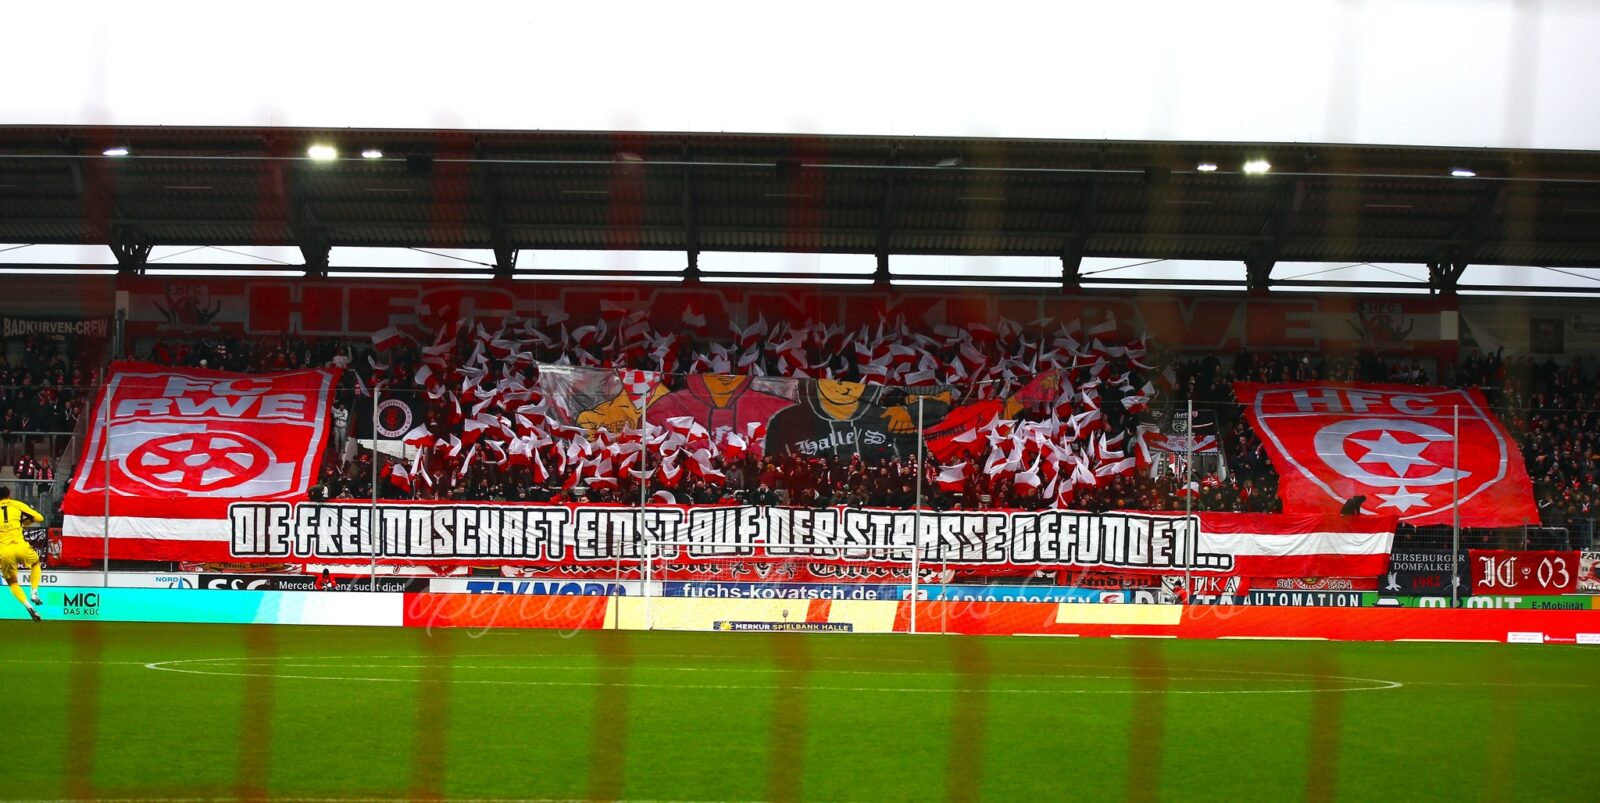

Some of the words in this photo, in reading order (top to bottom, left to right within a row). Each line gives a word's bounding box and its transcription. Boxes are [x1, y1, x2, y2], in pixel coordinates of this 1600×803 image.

[162, 375, 273, 398] FC
[115, 394, 307, 419] RWE
[1292, 389, 1439, 415] HFC
[230, 502, 292, 556] DIE
[294, 504, 570, 559] FREUNDSCHAFT
[577, 508, 684, 559] EINST
[689, 505, 762, 559] AUF
[767, 504, 840, 560] DER
[843, 510, 1010, 563] STRASSE
[1390, 553, 1465, 562] MERSEBURGR
[22, 574, 58, 583] NRD
[1537, 556, 1570, 589] 03
[354, 582, 380, 591] suct
[383, 582, 406, 591] dich!
[683, 583, 878, 600] fuchs-kovatsch.de
[1243, 592, 1360, 607] AUTOMATION
[772, 623, 819, 631] SPIELBANK
